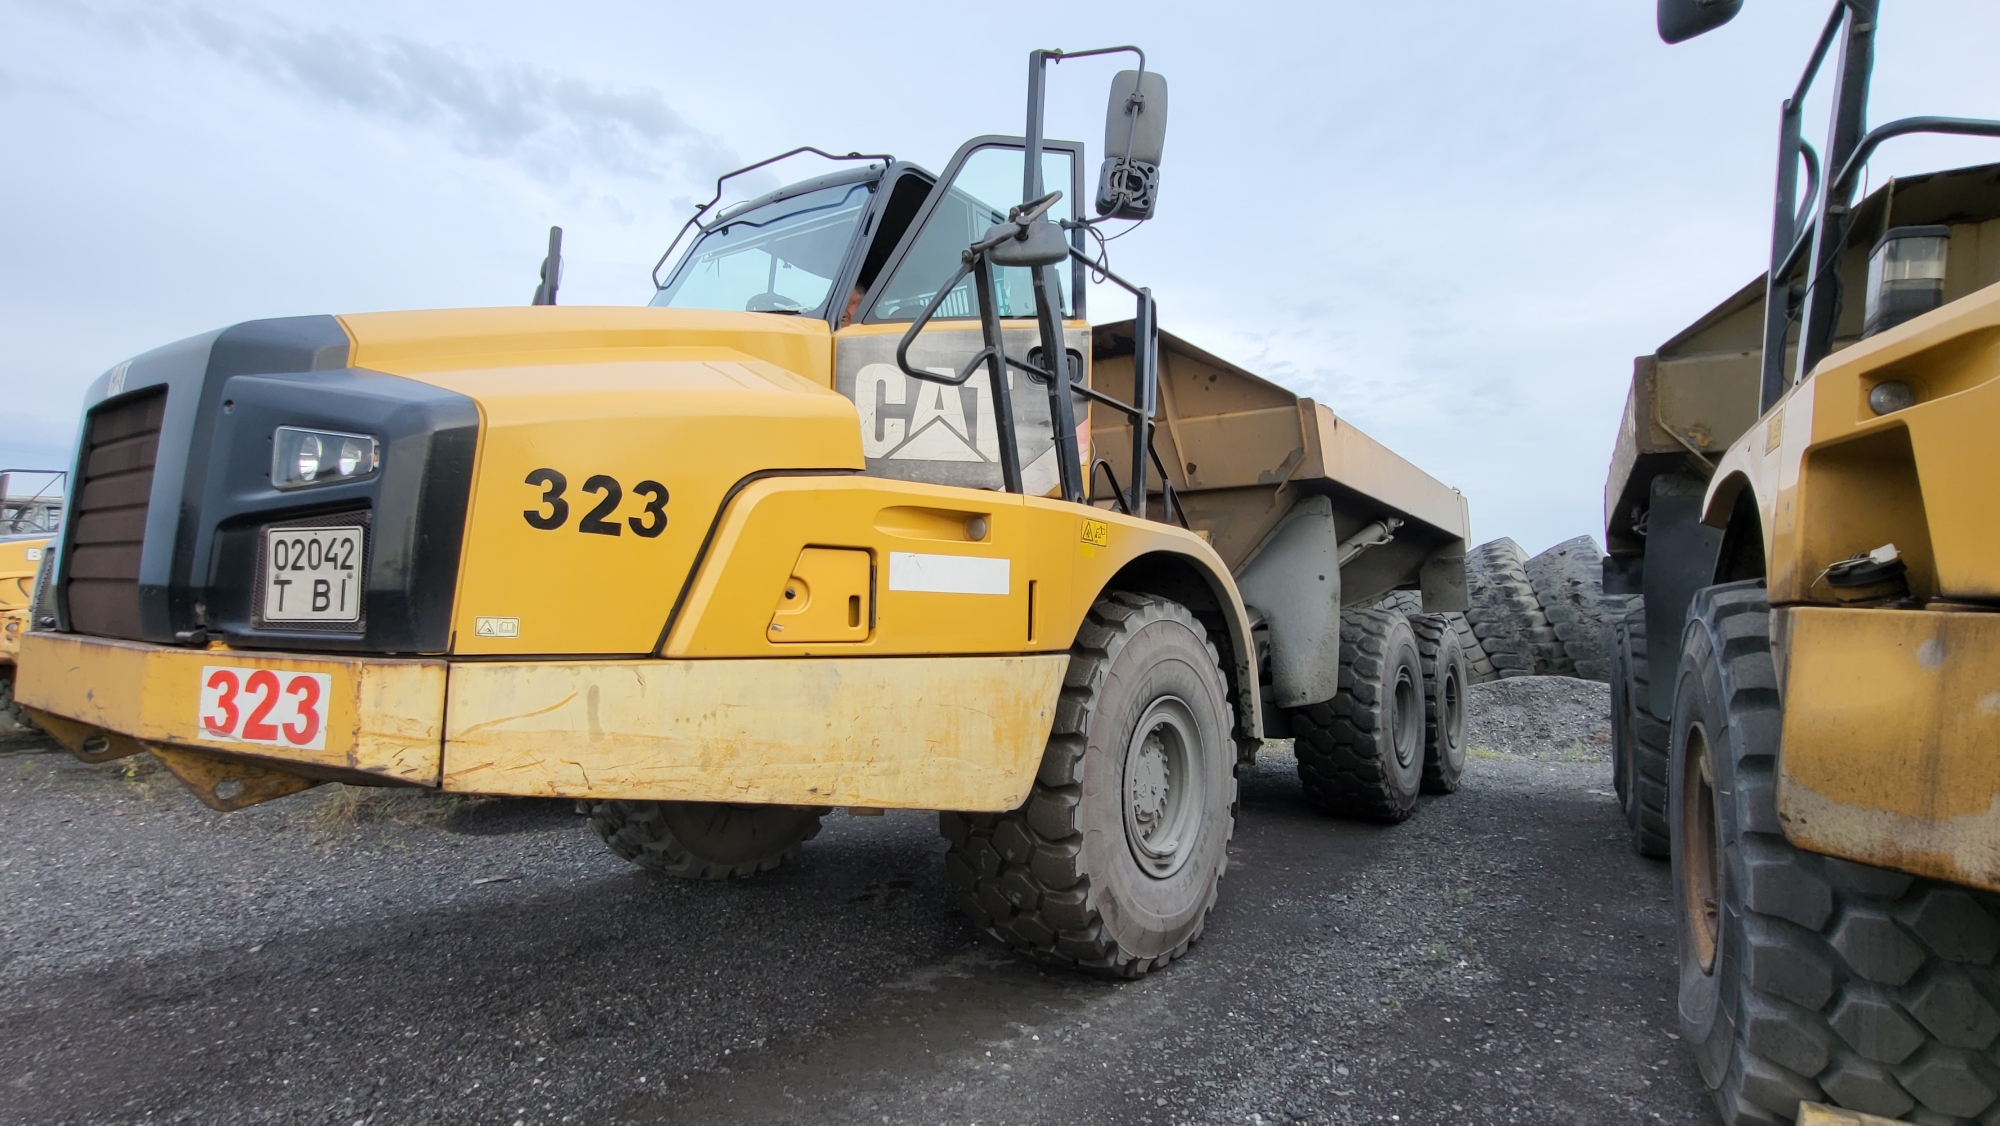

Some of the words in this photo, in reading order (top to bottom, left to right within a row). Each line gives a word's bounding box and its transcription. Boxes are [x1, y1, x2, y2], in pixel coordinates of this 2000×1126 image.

[855, 363, 1014, 463] CAT
[523, 467, 670, 539] 323
[274, 537, 355, 571] 02042
[273, 579, 293, 612] T
[312, 578, 347, 612] BI
[203, 669, 321, 746] 323
